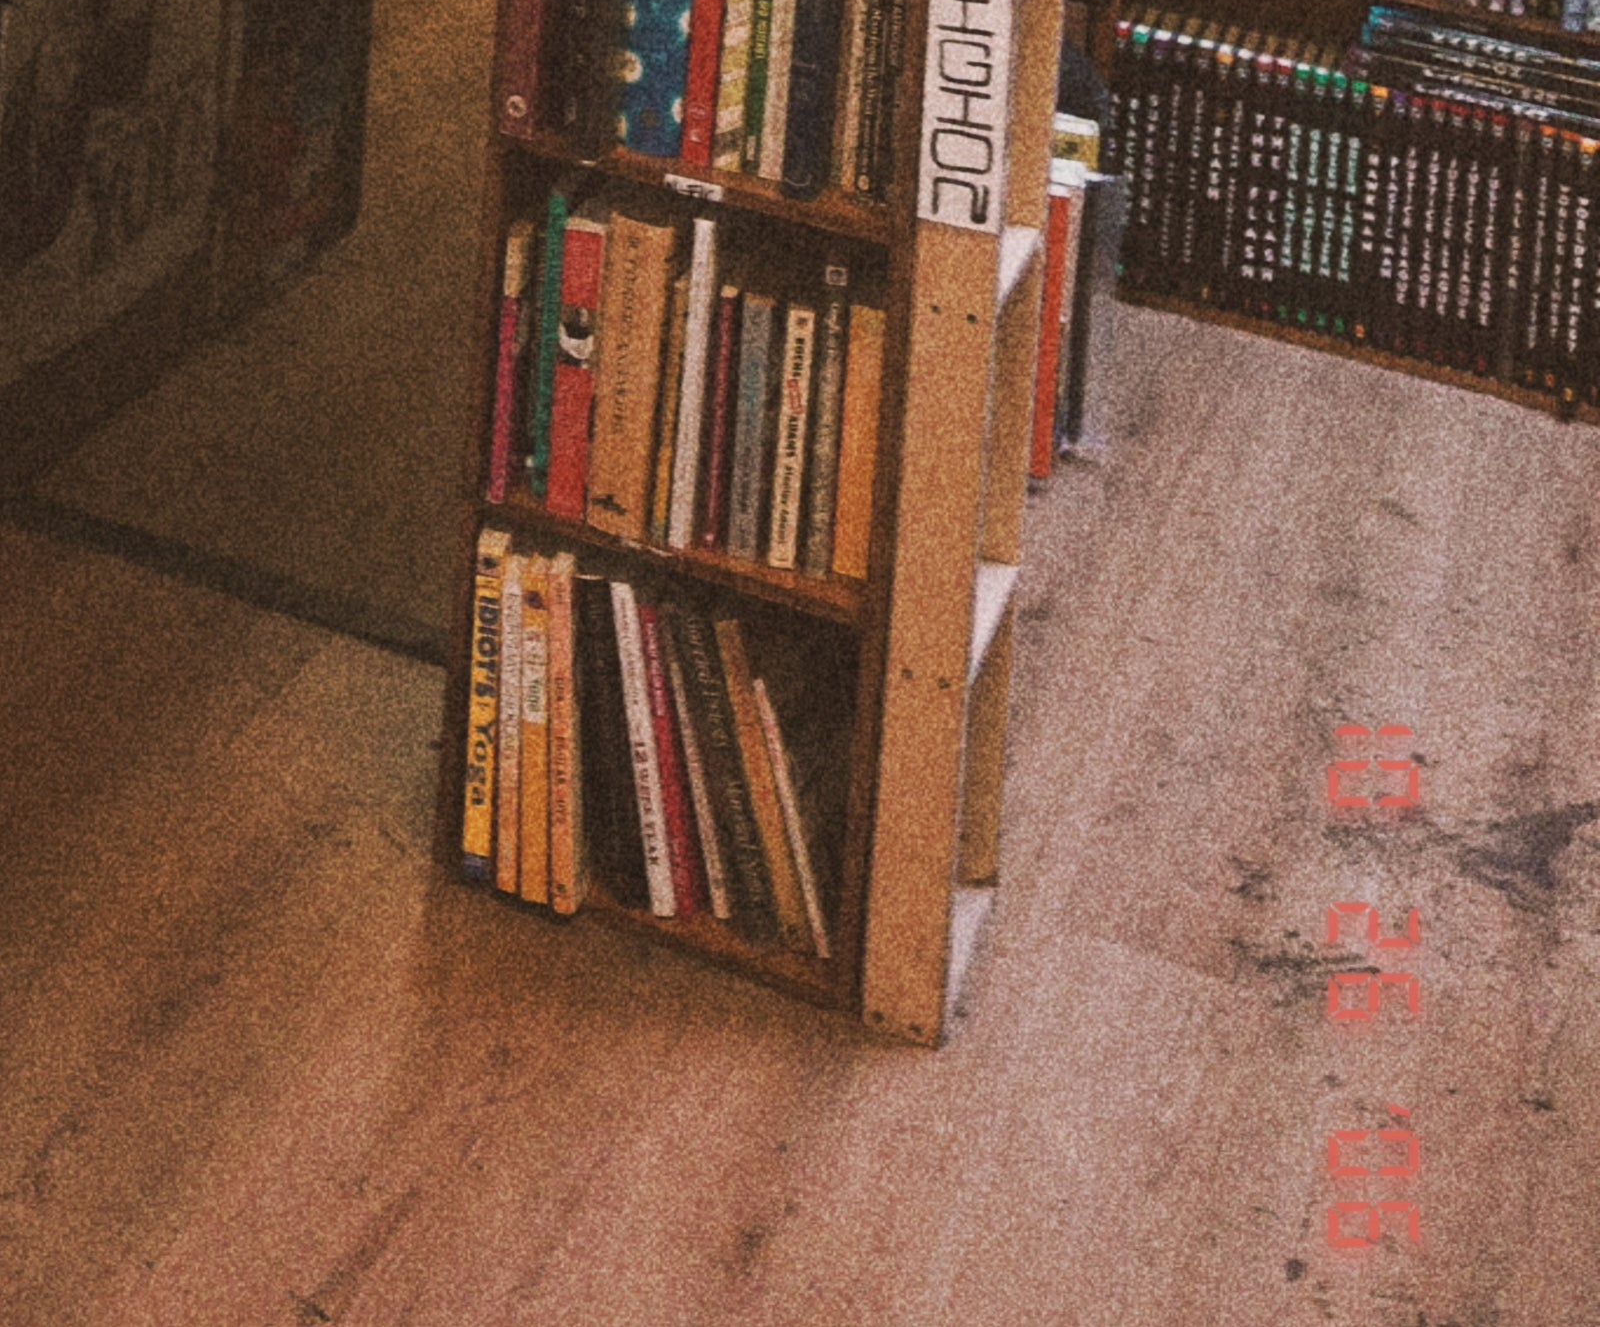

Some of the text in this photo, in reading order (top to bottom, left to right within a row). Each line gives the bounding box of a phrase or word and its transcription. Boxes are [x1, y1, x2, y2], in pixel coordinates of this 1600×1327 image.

[1240, 186, 1260, 279] FLASH
[1259, 188, 1279, 281] FLASH
[468, 595, 498, 808] IDIOT'S Yoga
